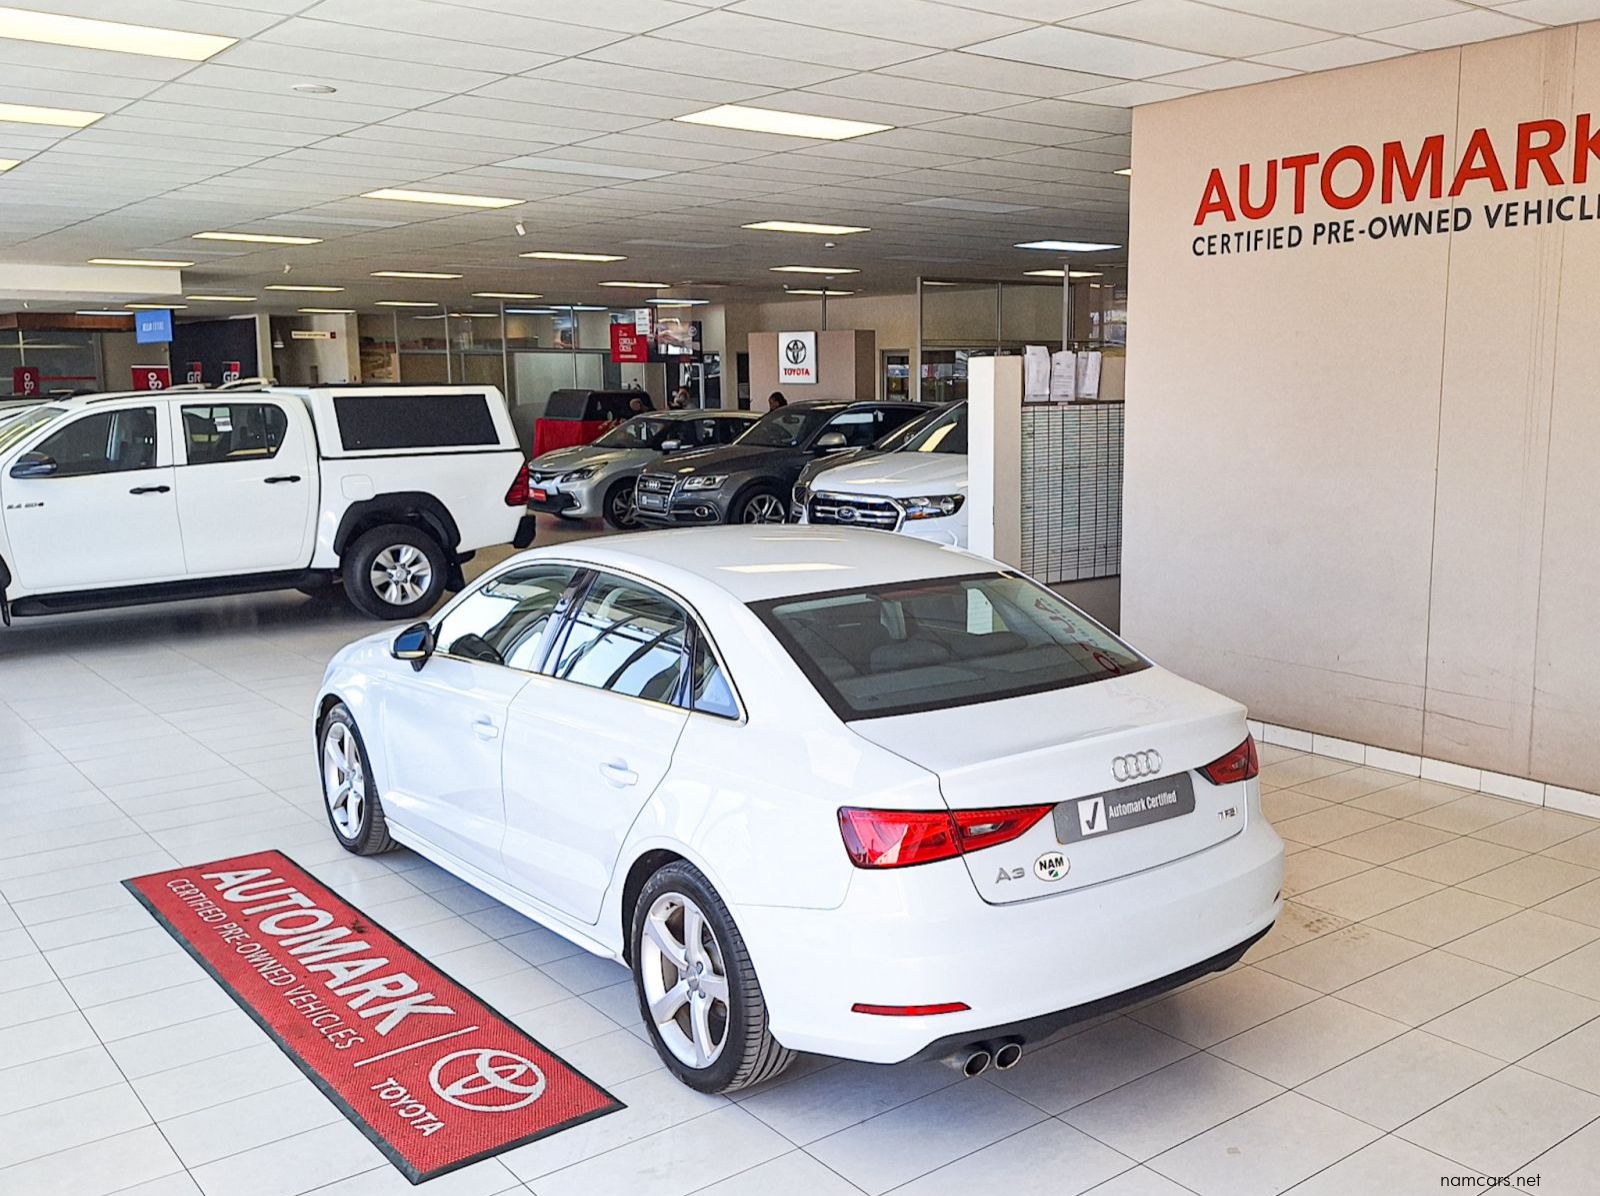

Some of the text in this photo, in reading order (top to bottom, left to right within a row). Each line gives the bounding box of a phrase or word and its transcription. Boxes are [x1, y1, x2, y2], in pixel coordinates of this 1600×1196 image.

[1193, 113, 1600, 226] AUTOMARK
[1192, 193, 1600, 257] CERTIFIED PRE-OWNED VEHICL
[187, 371, 201, 383] GR
[783, 367, 810, 376] TOYOTA
[1108, 789, 1178, 819] Automark Certified
[994, 867, 1025, 884] A3
[1038, 856, 1064, 872] NAM
[165, 877, 366, 1051] CERTIFIED PRE-OWNED VEHICLES
[200, 867, 456, 1037] AUTOMARK
[370, 1076, 446, 1137] TOYOTA
